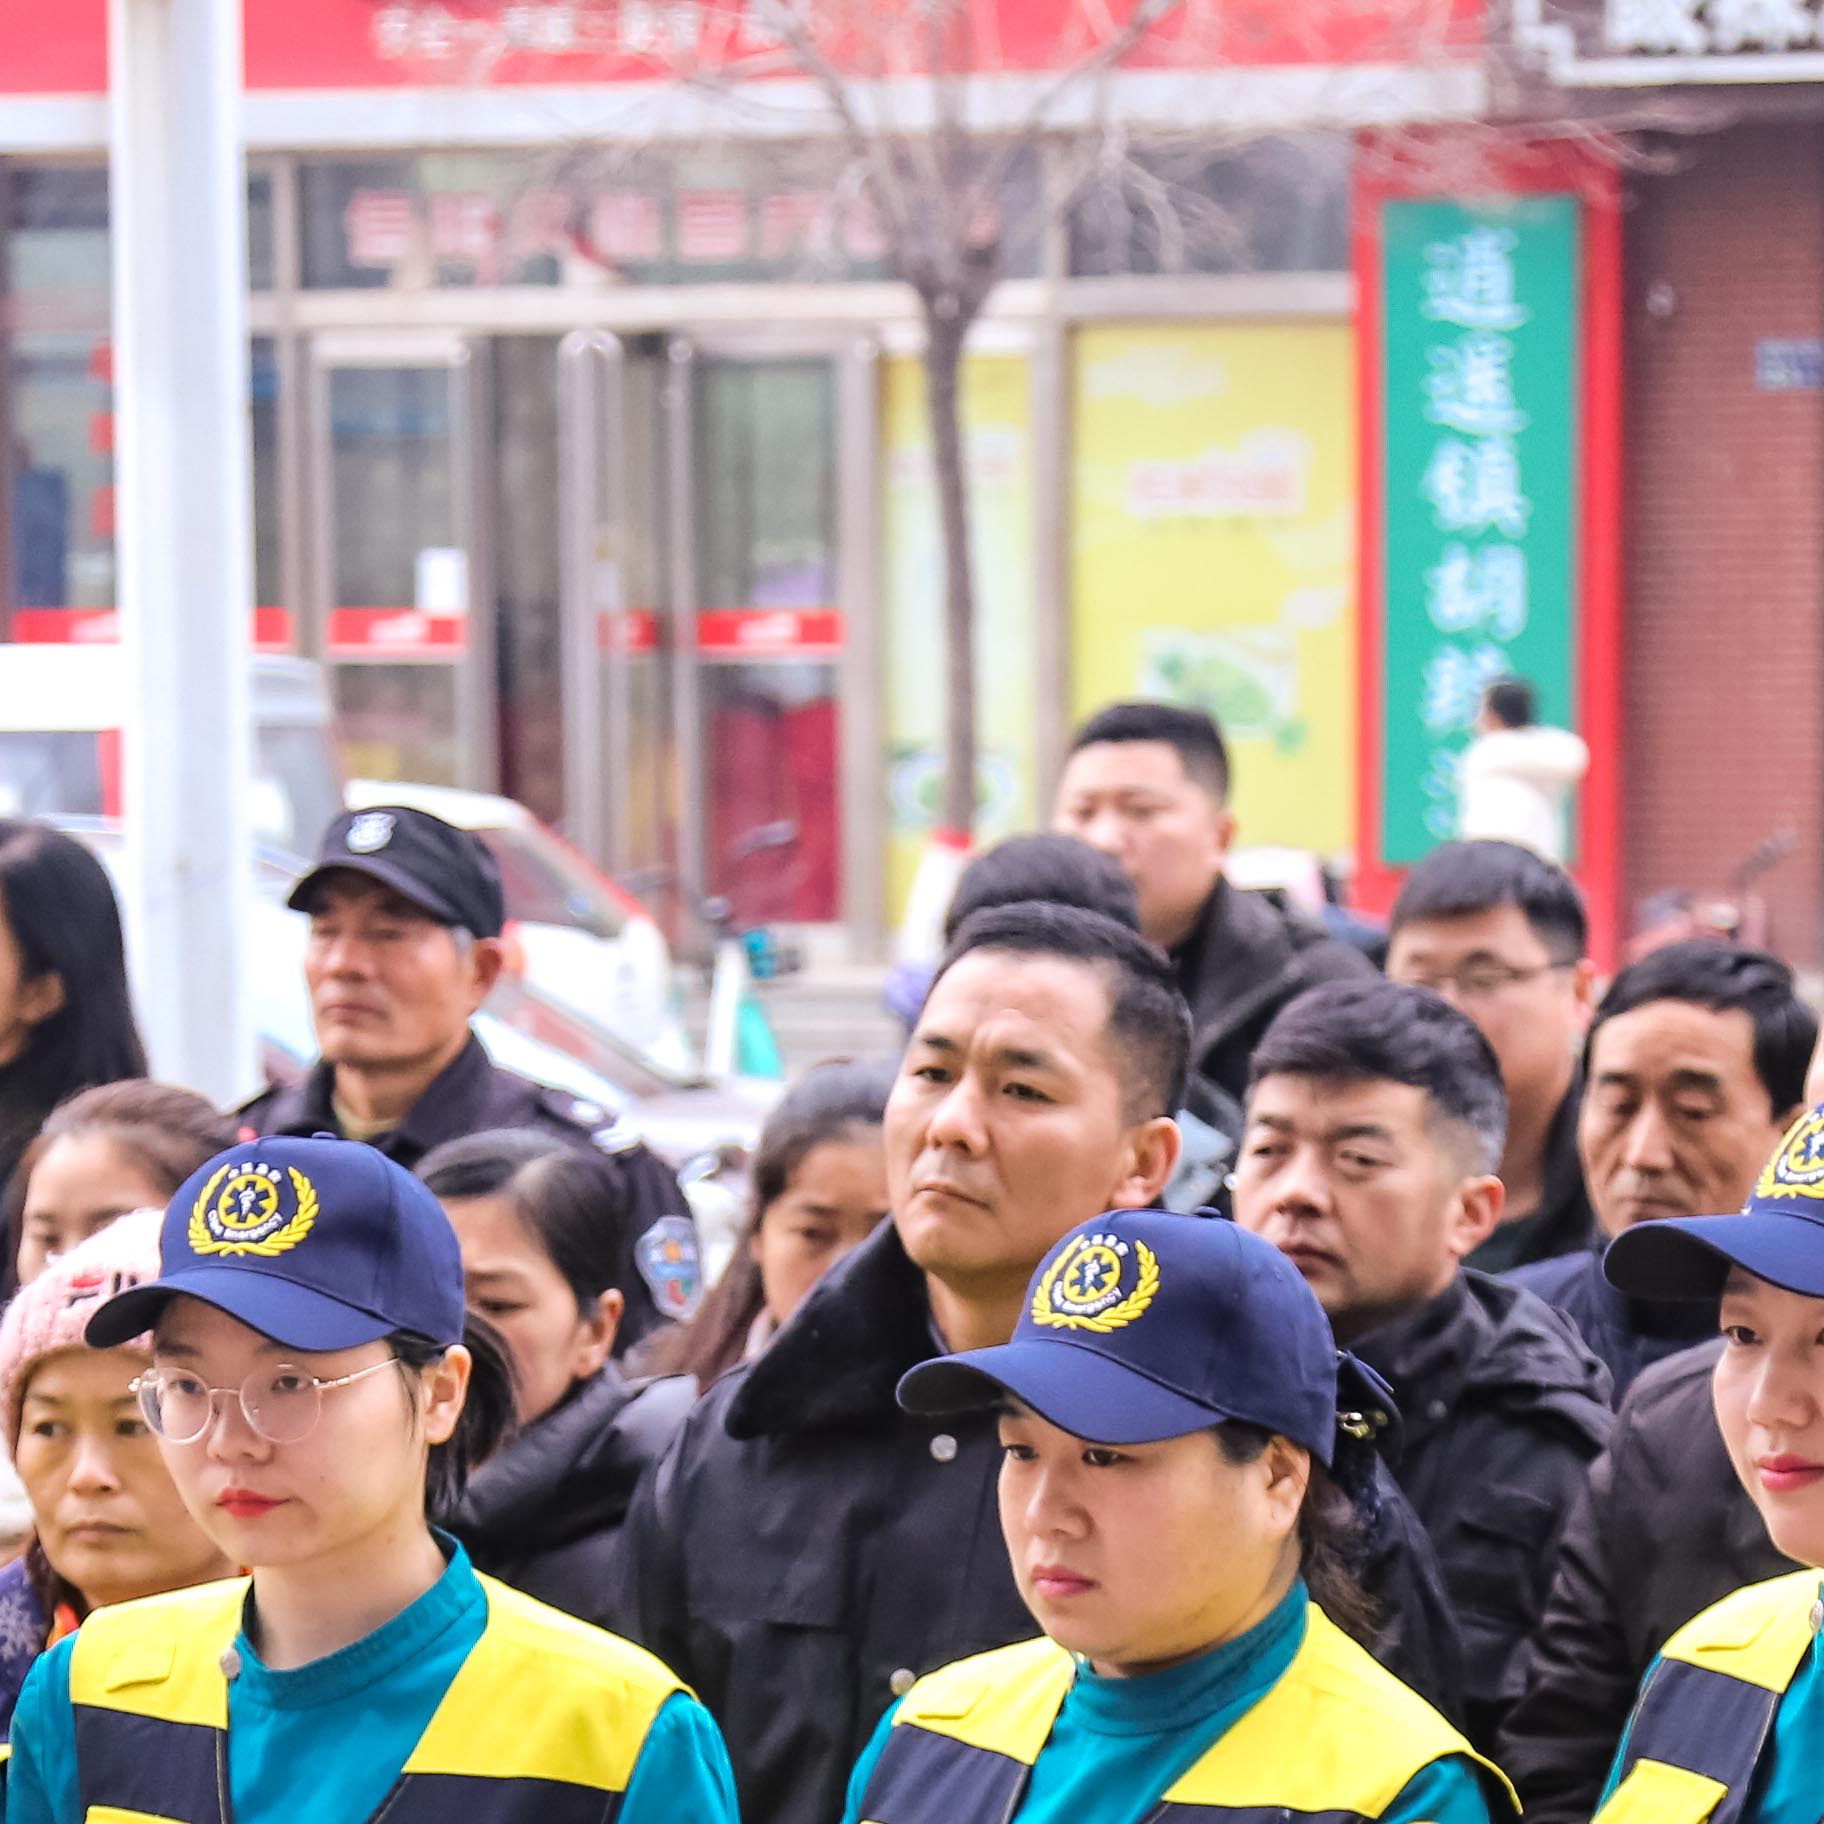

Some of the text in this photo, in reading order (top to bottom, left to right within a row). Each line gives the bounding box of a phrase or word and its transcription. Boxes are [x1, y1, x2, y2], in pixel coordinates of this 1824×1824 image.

[1420, 226, 1530, 838] 逍遥镇胡辣
